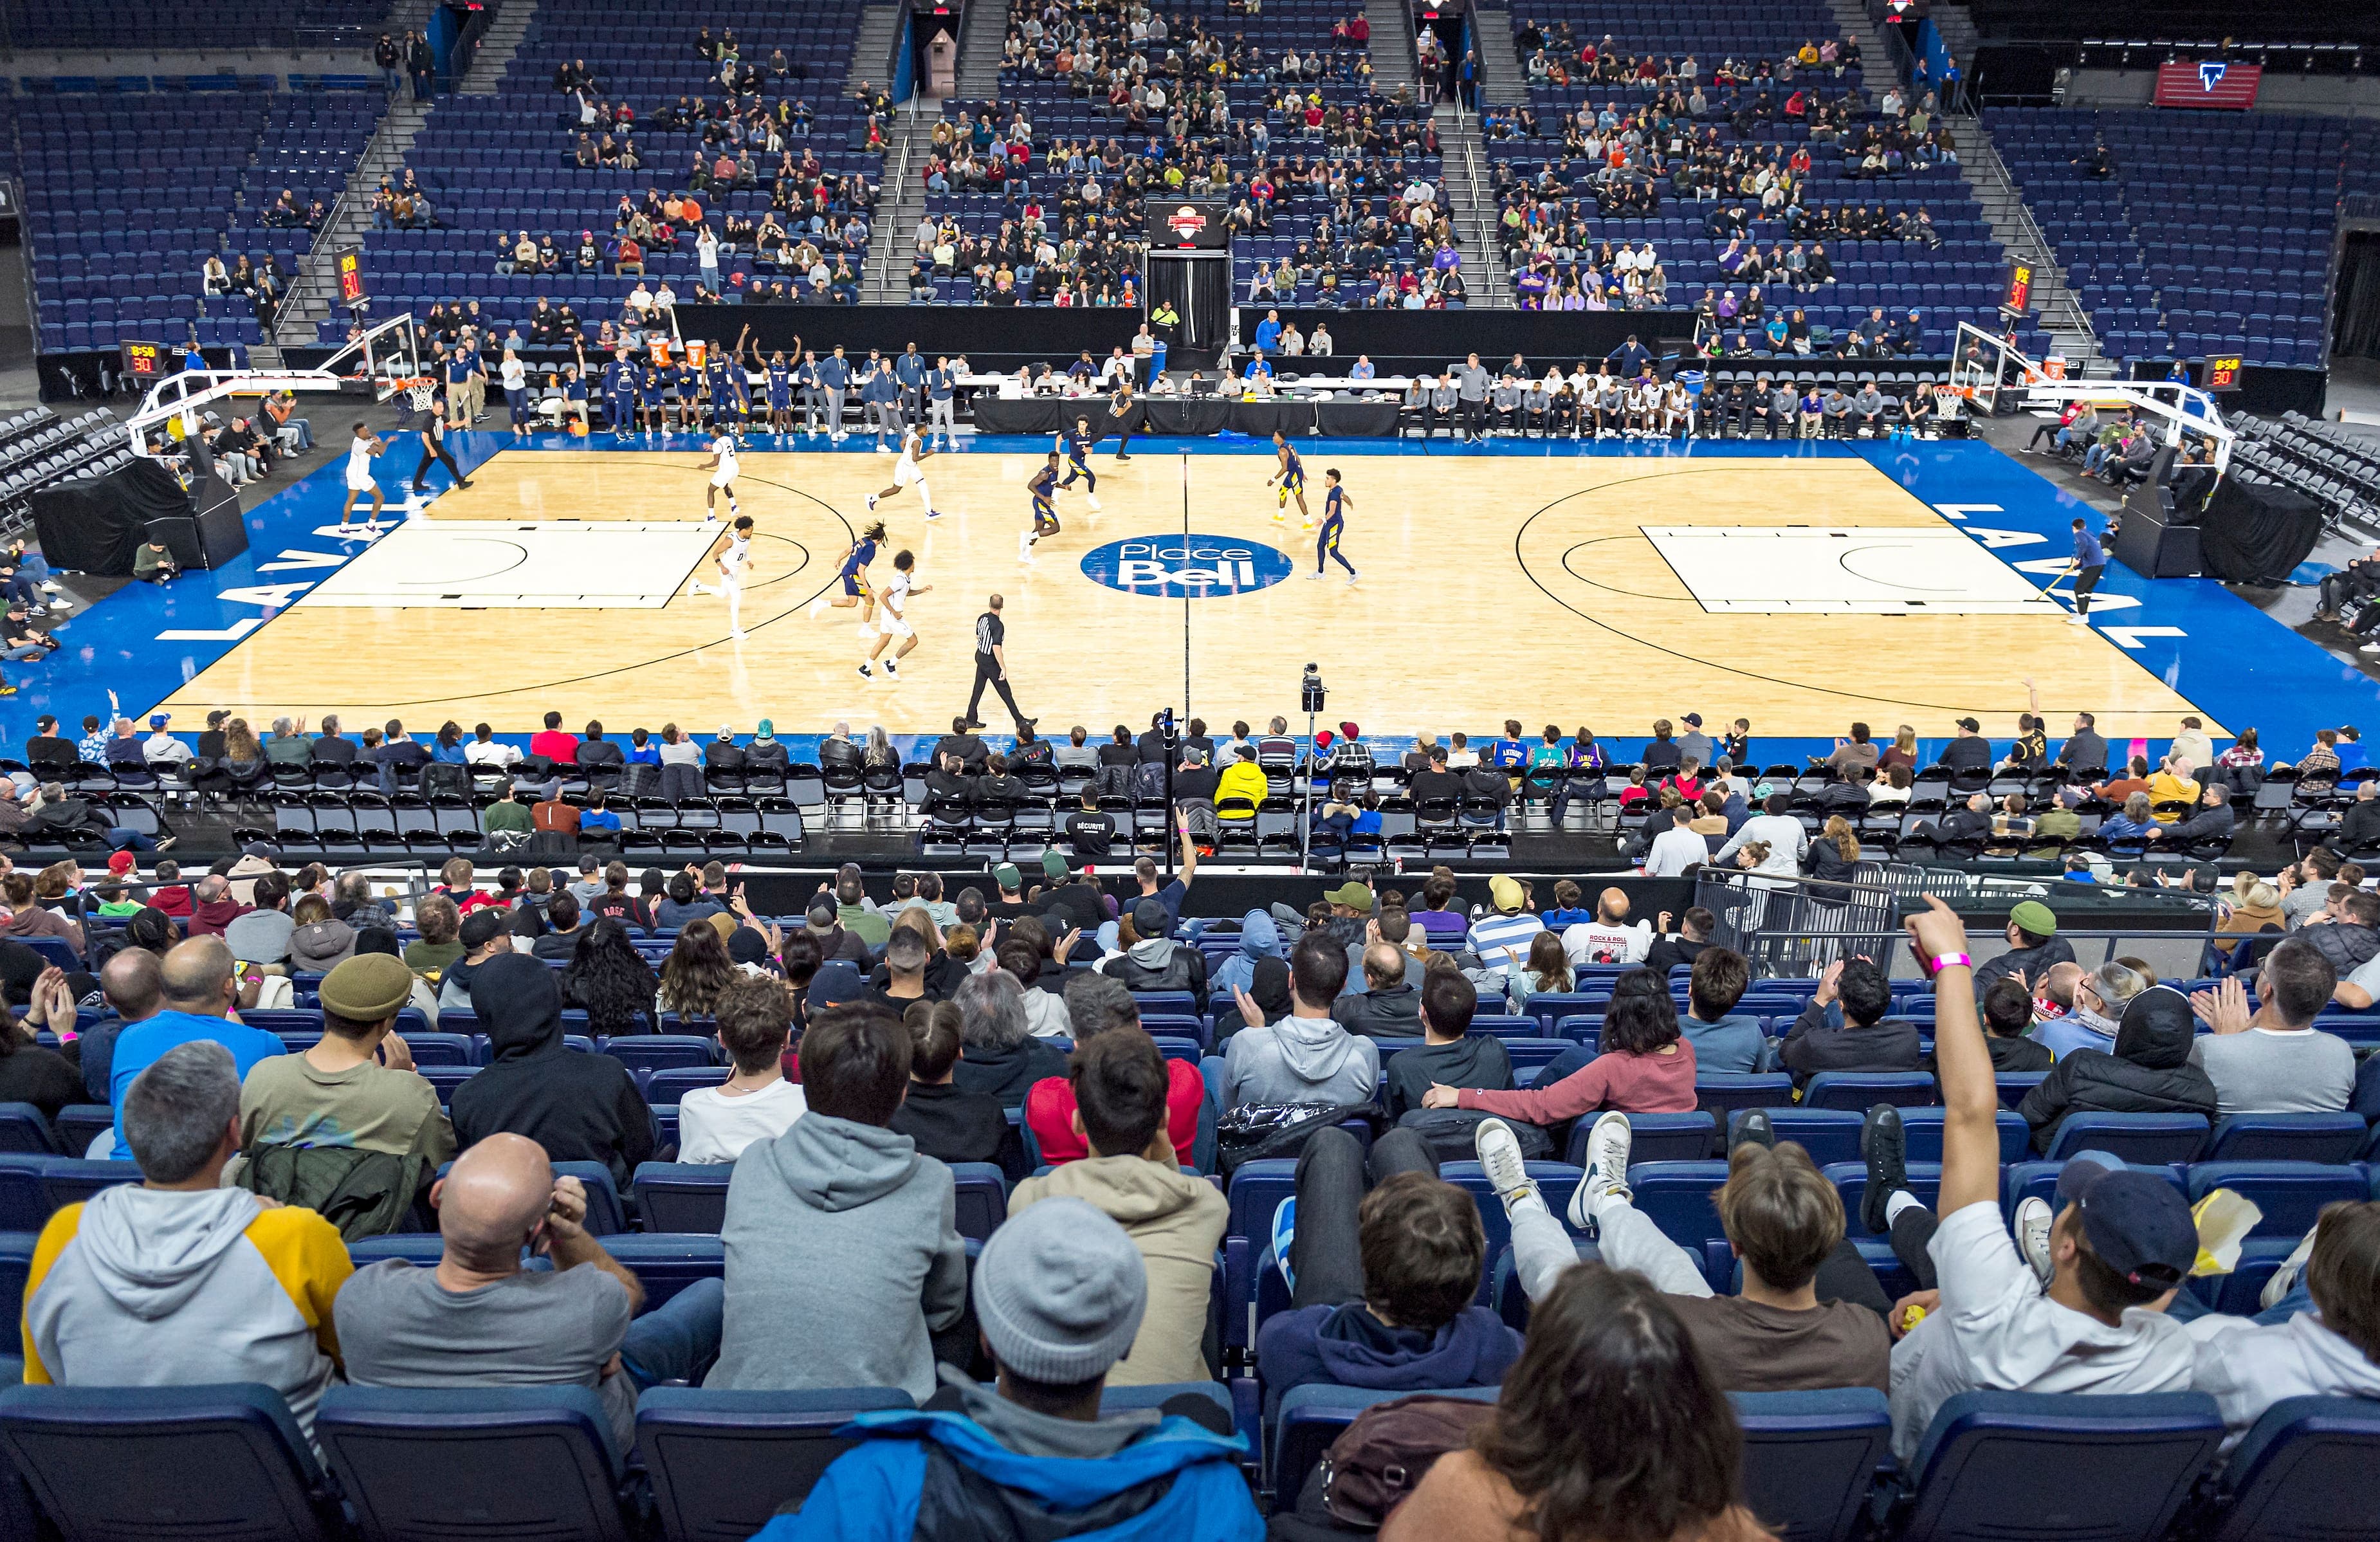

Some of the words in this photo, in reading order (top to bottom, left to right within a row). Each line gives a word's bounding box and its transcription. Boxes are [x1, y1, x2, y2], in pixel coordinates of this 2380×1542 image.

[132, 345, 155, 357] 8:58
[133, 357, 151, 371] 30
[2215, 359, 2238, 371] 8:58
[2213, 371, 2230, 384] 30
[1119, 544, 1252, 560] Place
[154, 496, 430, 641] LAVAL
[1117, 560, 1255, 586] Bell
[1932, 504, 2188, 648] LAVAL
[1503, 749, 1524, 758] ANTHONY
[1077, 821, 1106, 831] SÉCURITÉ
[603, 906, 625, 917] ROSE
